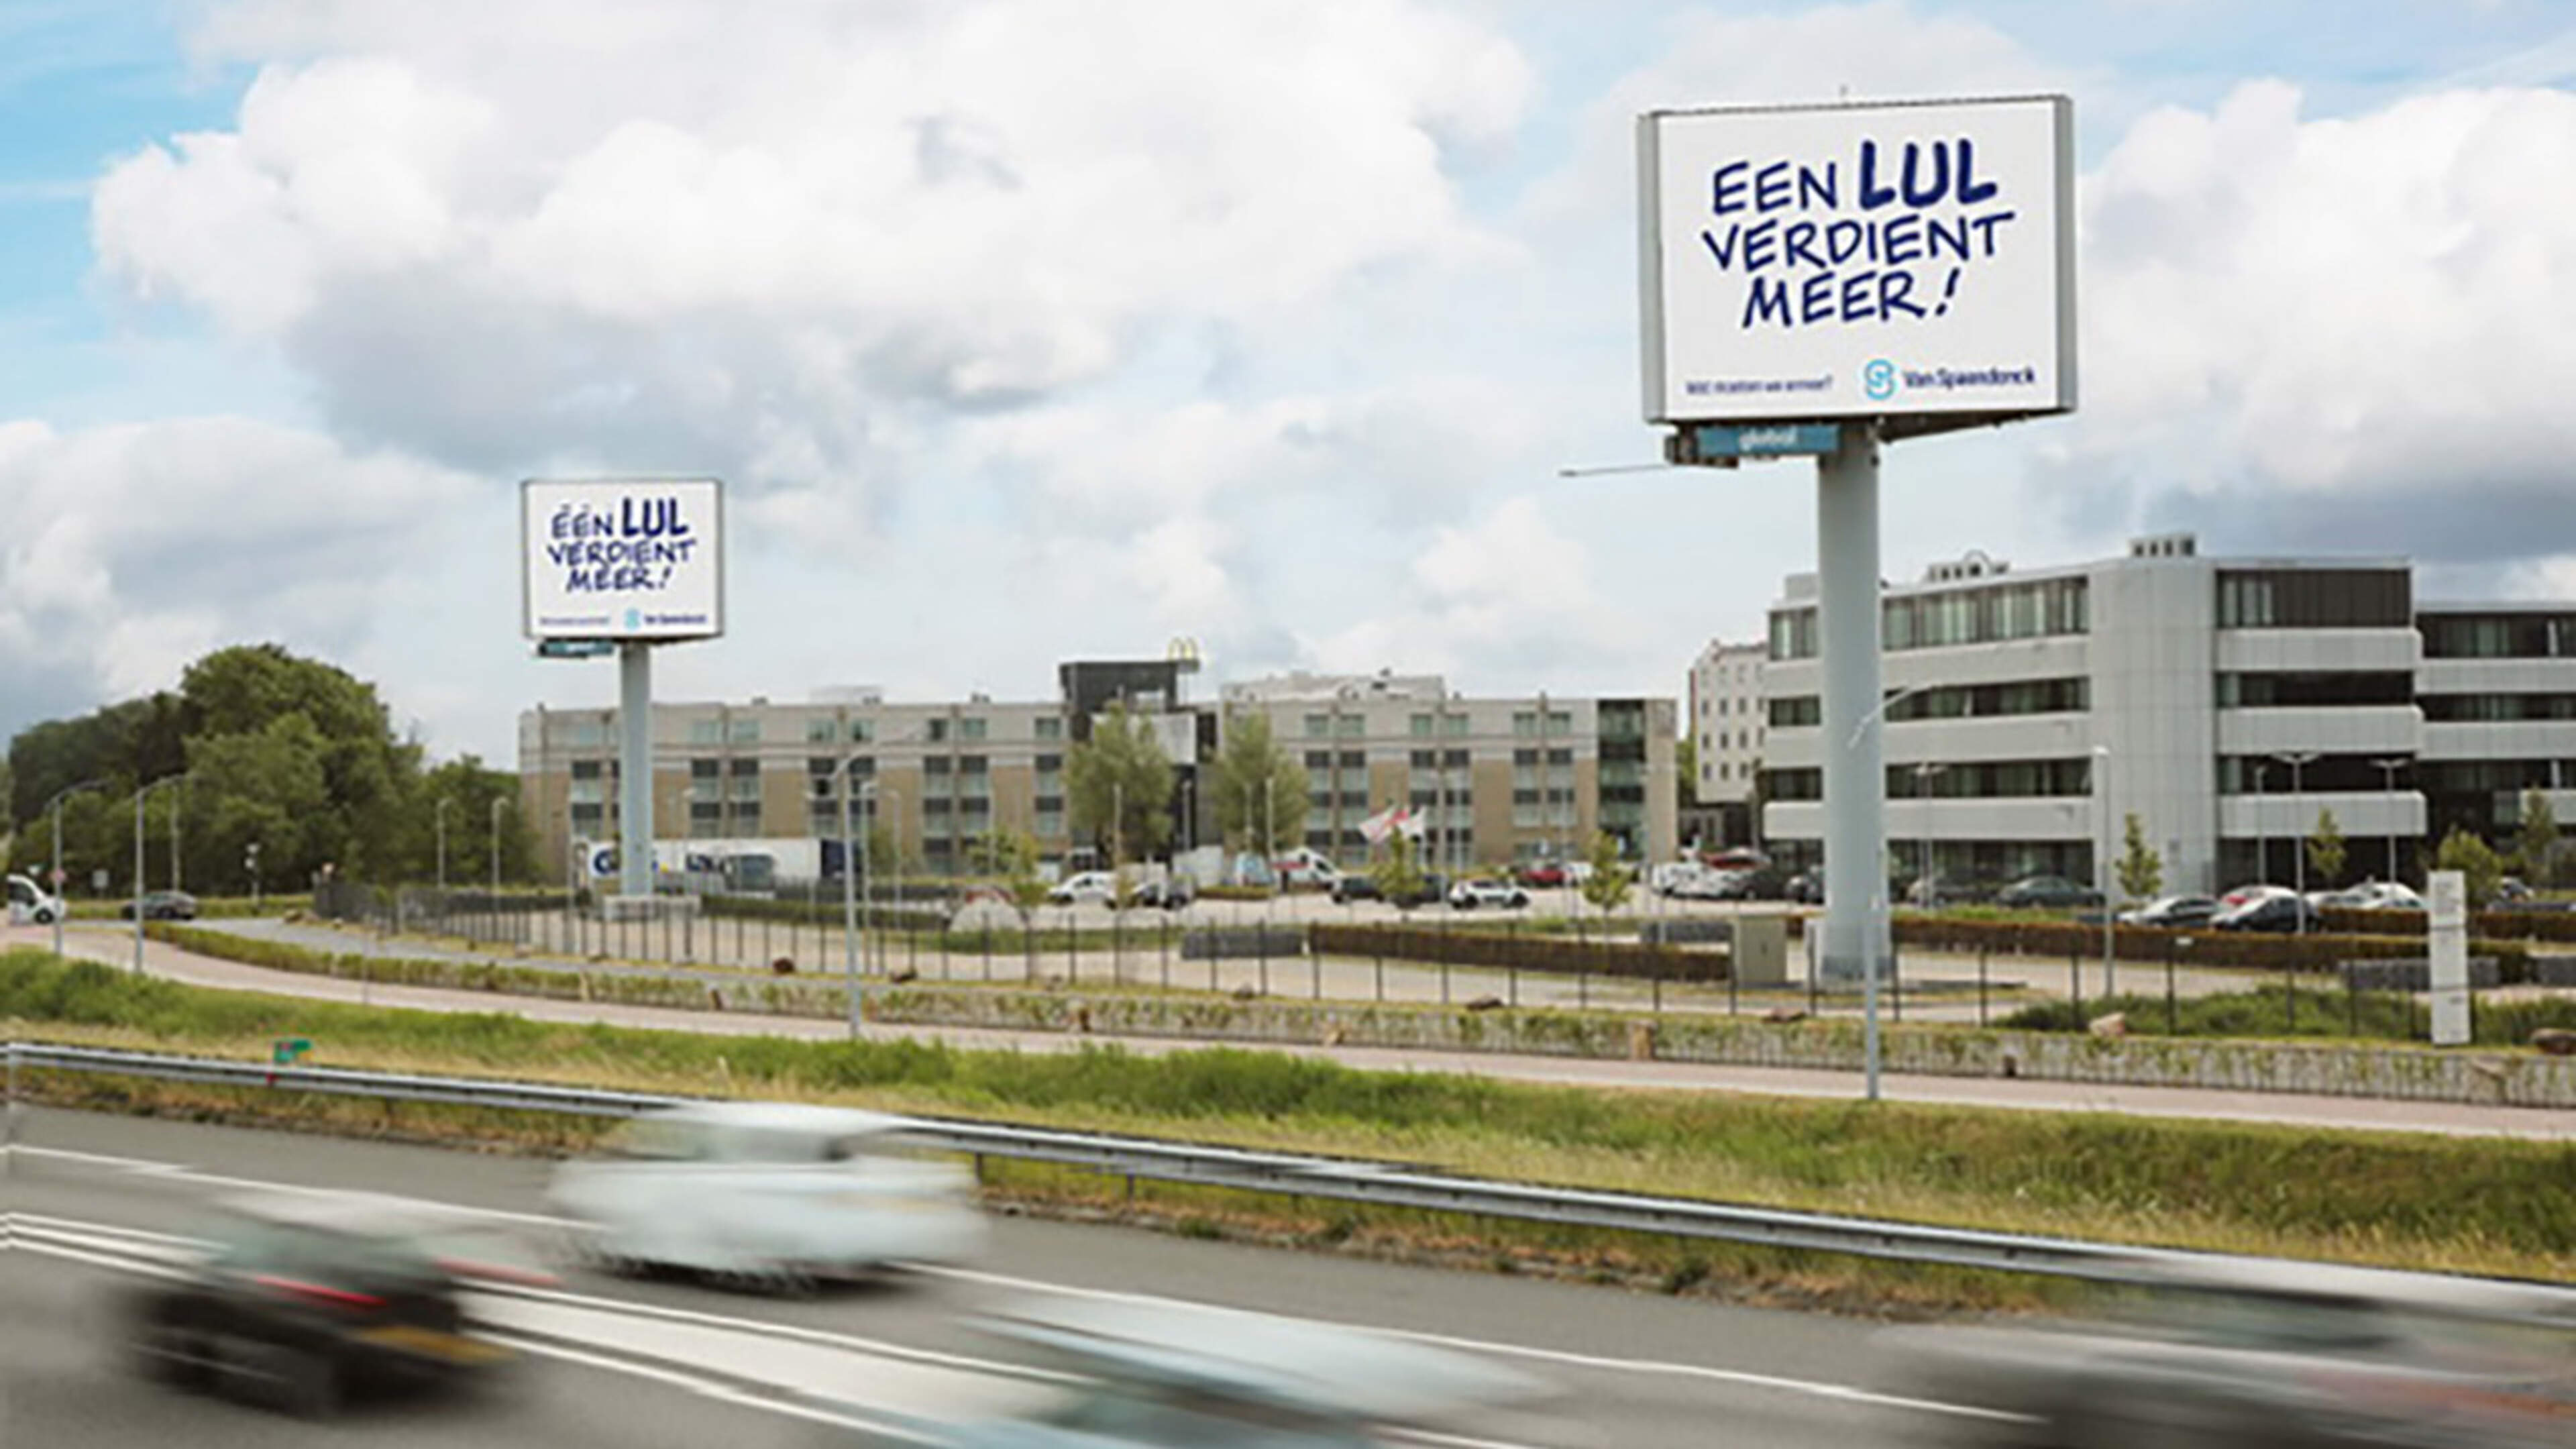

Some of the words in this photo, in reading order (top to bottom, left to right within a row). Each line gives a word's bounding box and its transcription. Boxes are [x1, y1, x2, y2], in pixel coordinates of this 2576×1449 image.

[1713, 160, 1839, 216] EEN
[1858, 138, 1998, 211] LUL
[1701, 211, 2016, 274] VERDIENT
[1741, 267, 1961, 329] MEER!
[621, 497, 689, 538] LUL
[546, 537, 696, 566] VERDIENT
[566, 566, 672, 593] MEER!
